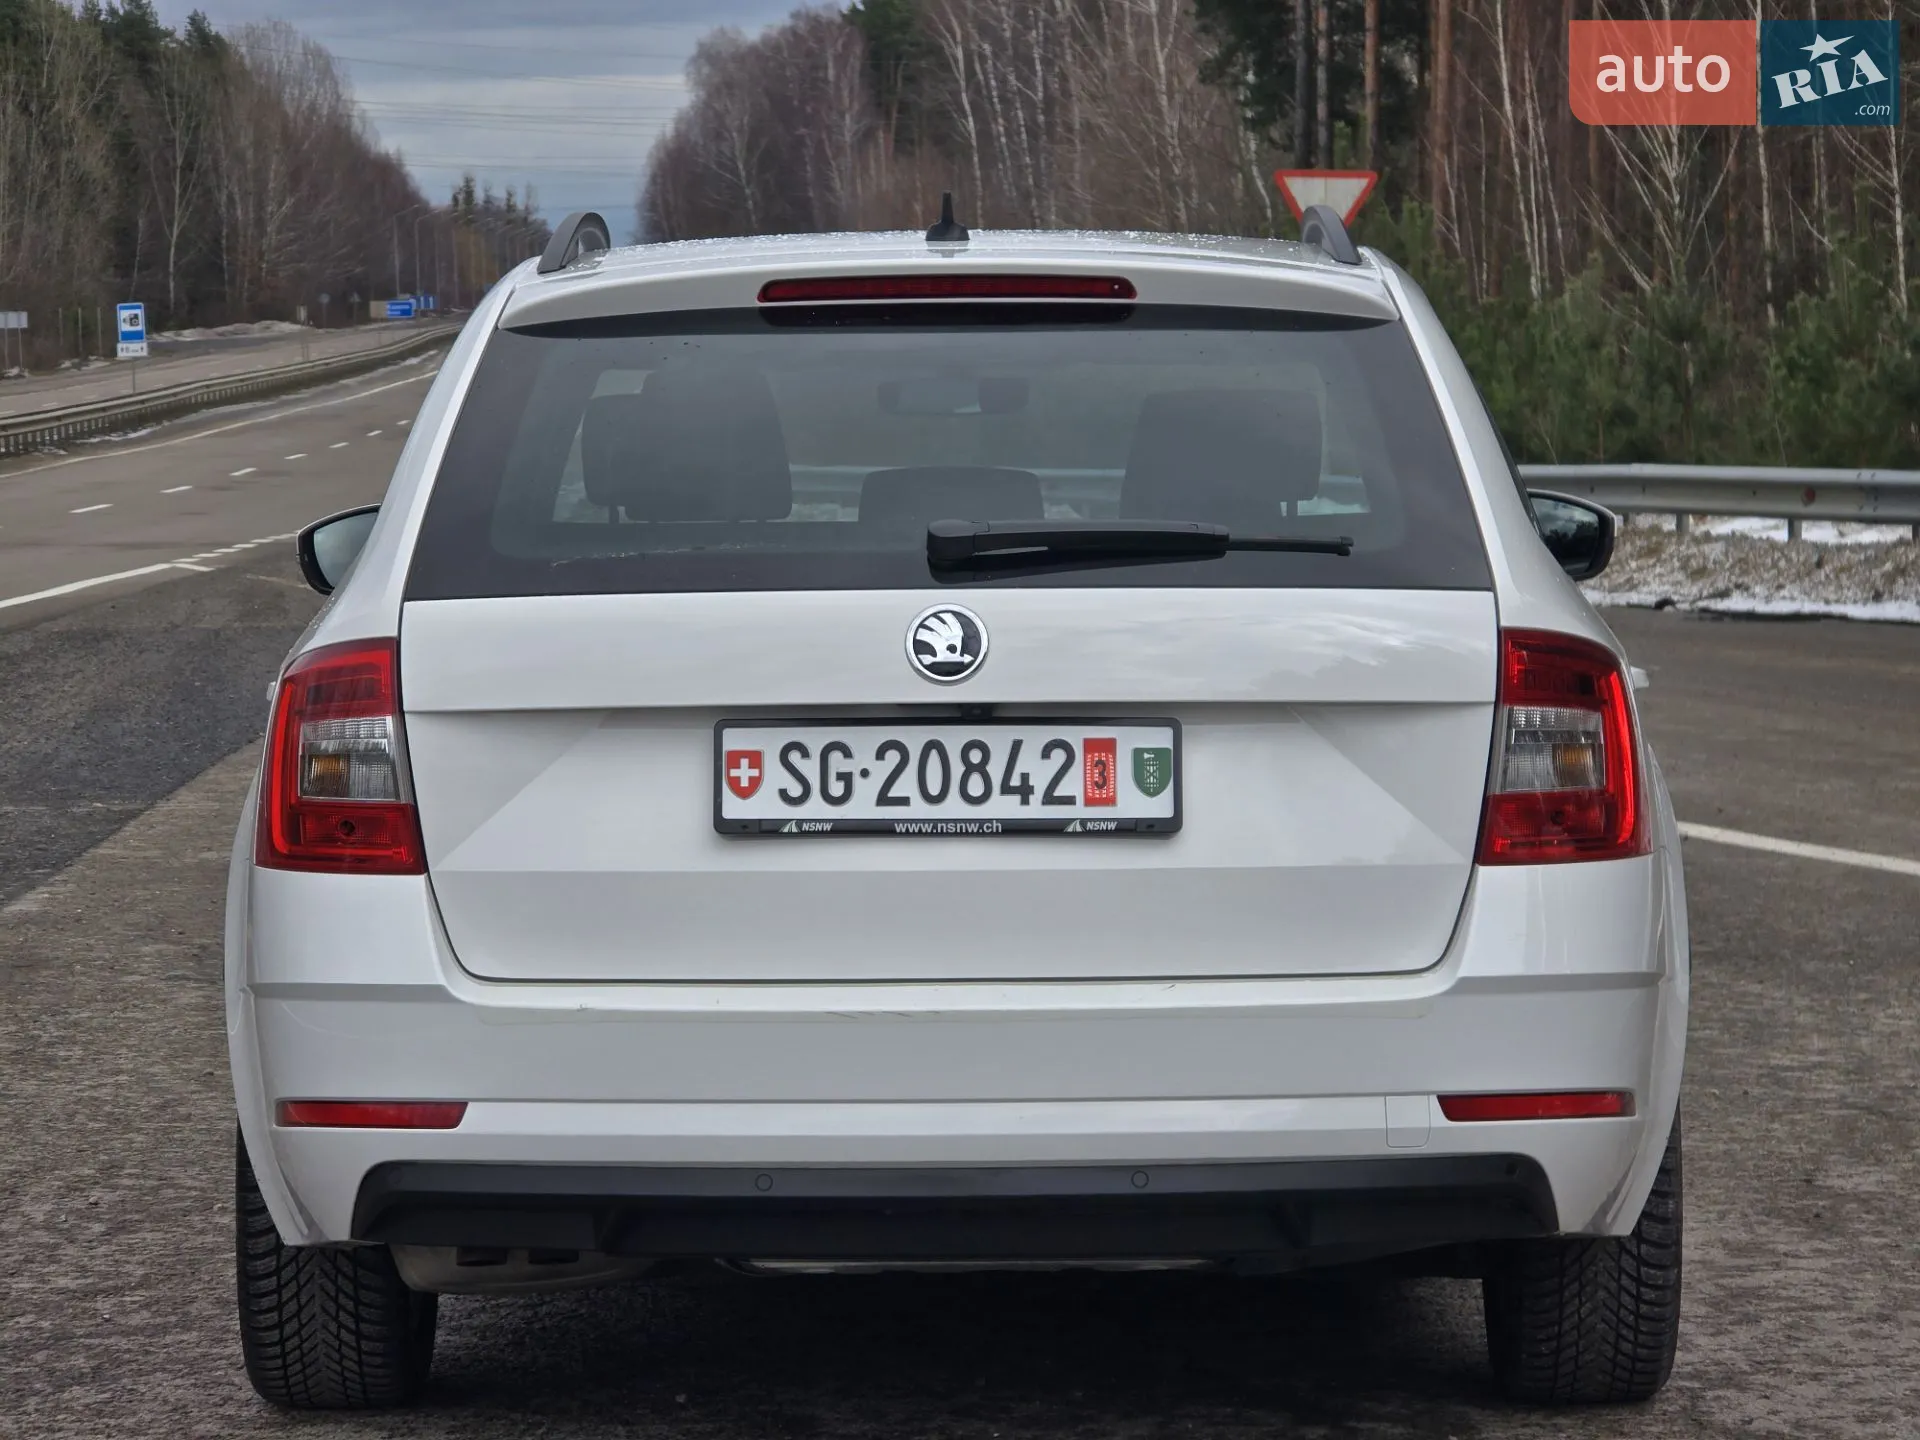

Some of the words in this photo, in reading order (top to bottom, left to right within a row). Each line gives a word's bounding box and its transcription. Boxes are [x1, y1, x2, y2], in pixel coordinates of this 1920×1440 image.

[1094, 759, 1108, 790] 3
[802, 822, 833, 832] NSNW
[894, 820, 1002, 834] www.nsnw.ch
[1086, 821, 1118, 831] NSNW
